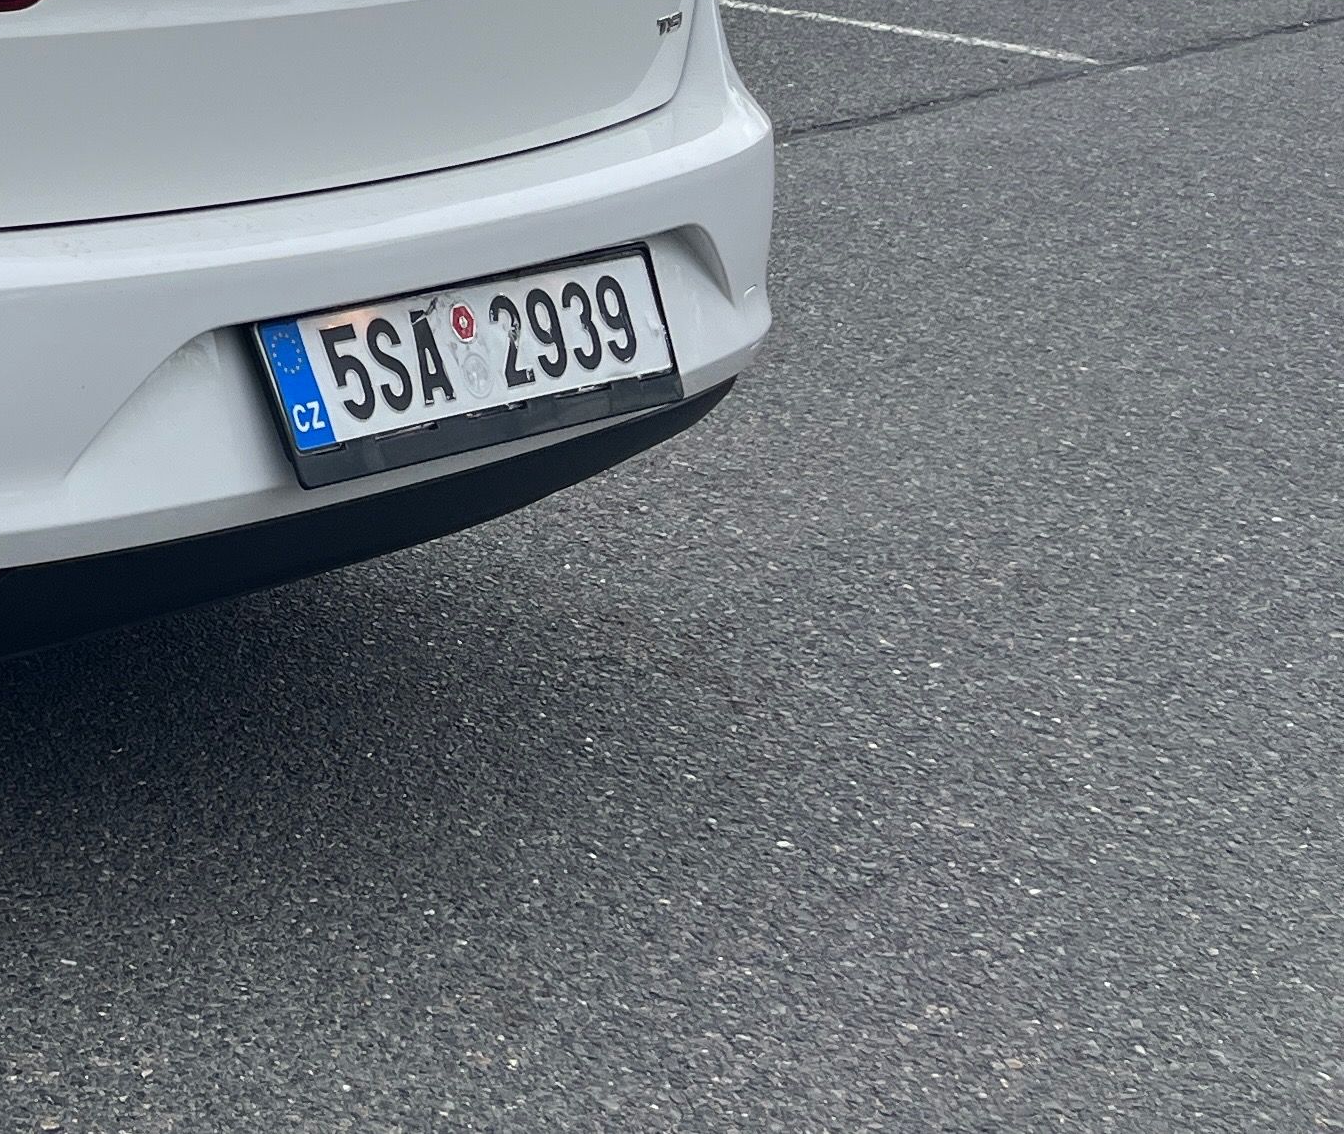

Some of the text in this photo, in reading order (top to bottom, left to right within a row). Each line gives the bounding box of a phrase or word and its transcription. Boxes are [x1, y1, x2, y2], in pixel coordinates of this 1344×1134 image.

[318, 274, 638, 421] 5SA 2939
[292, 400, 326, 433] CZ
